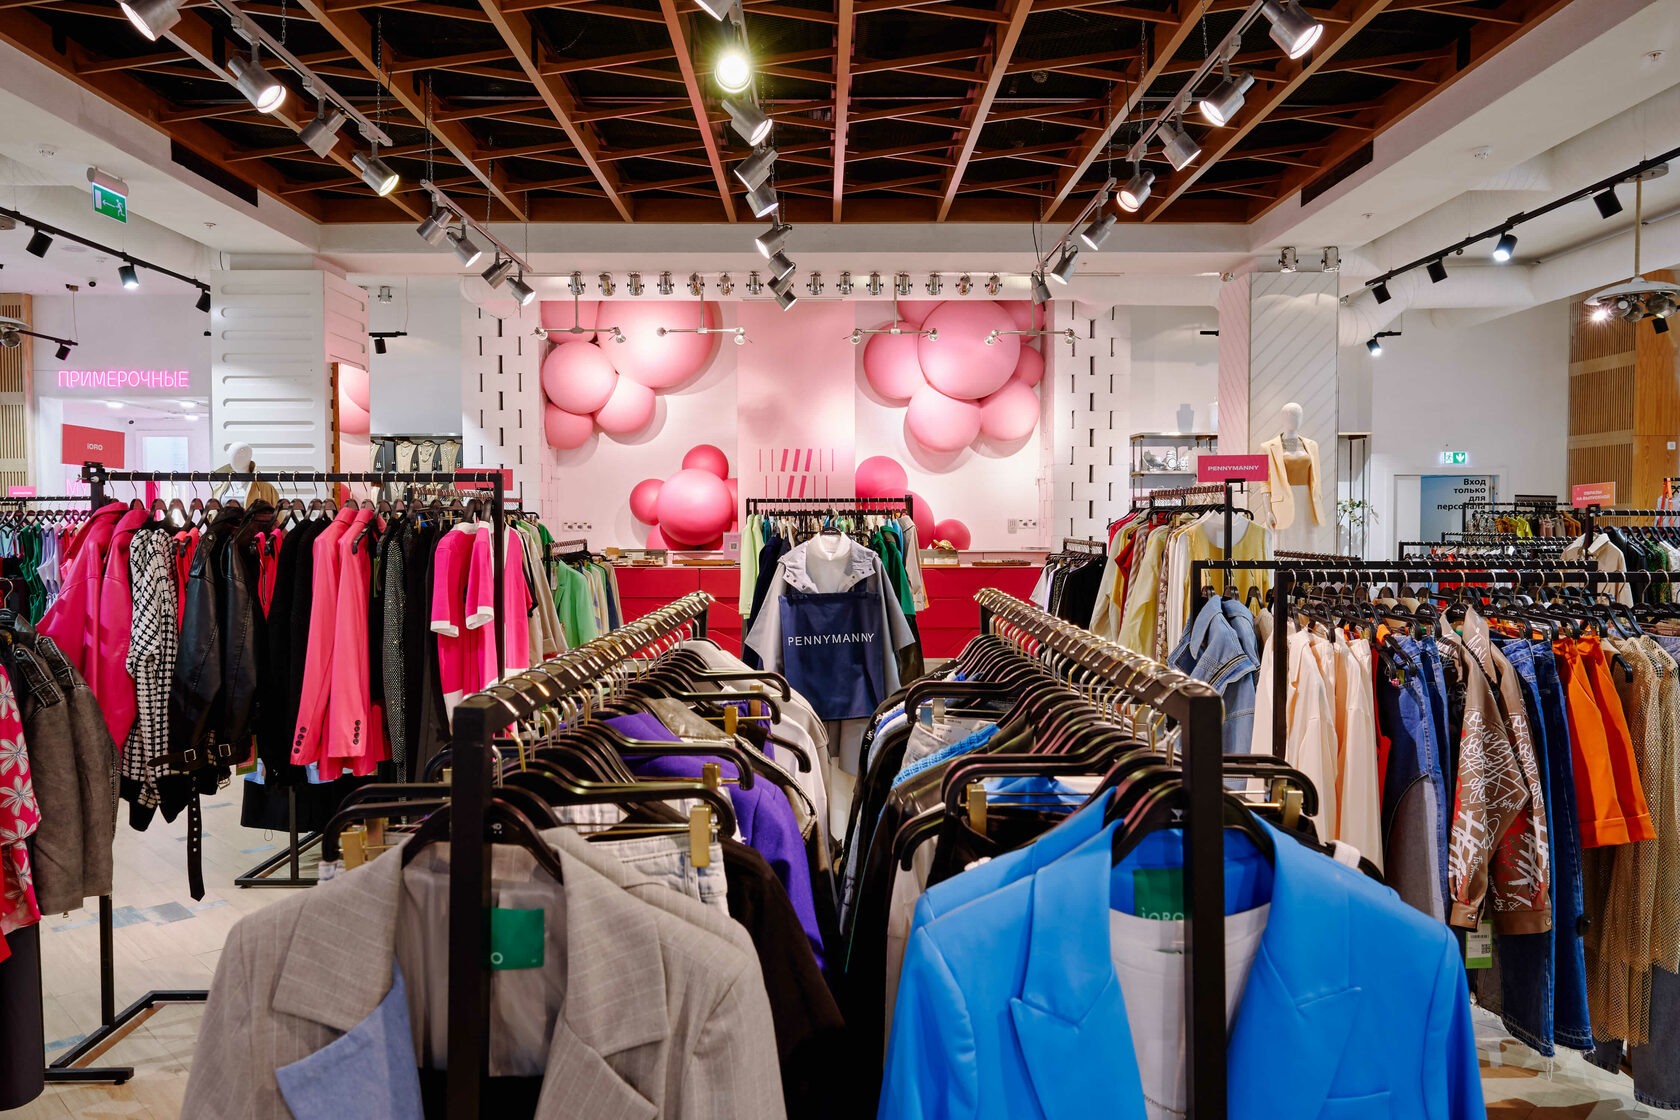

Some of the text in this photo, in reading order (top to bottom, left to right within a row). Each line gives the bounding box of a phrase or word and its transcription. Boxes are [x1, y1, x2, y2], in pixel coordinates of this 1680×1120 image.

[57, 370, 190, 388] ПРИМЕРОЧНЫЕ
[1463, 478, 1486, 486] Вход
[1468, 495, 1486, 503] для
[787, 633, 874, 646] PENNYMANNY
